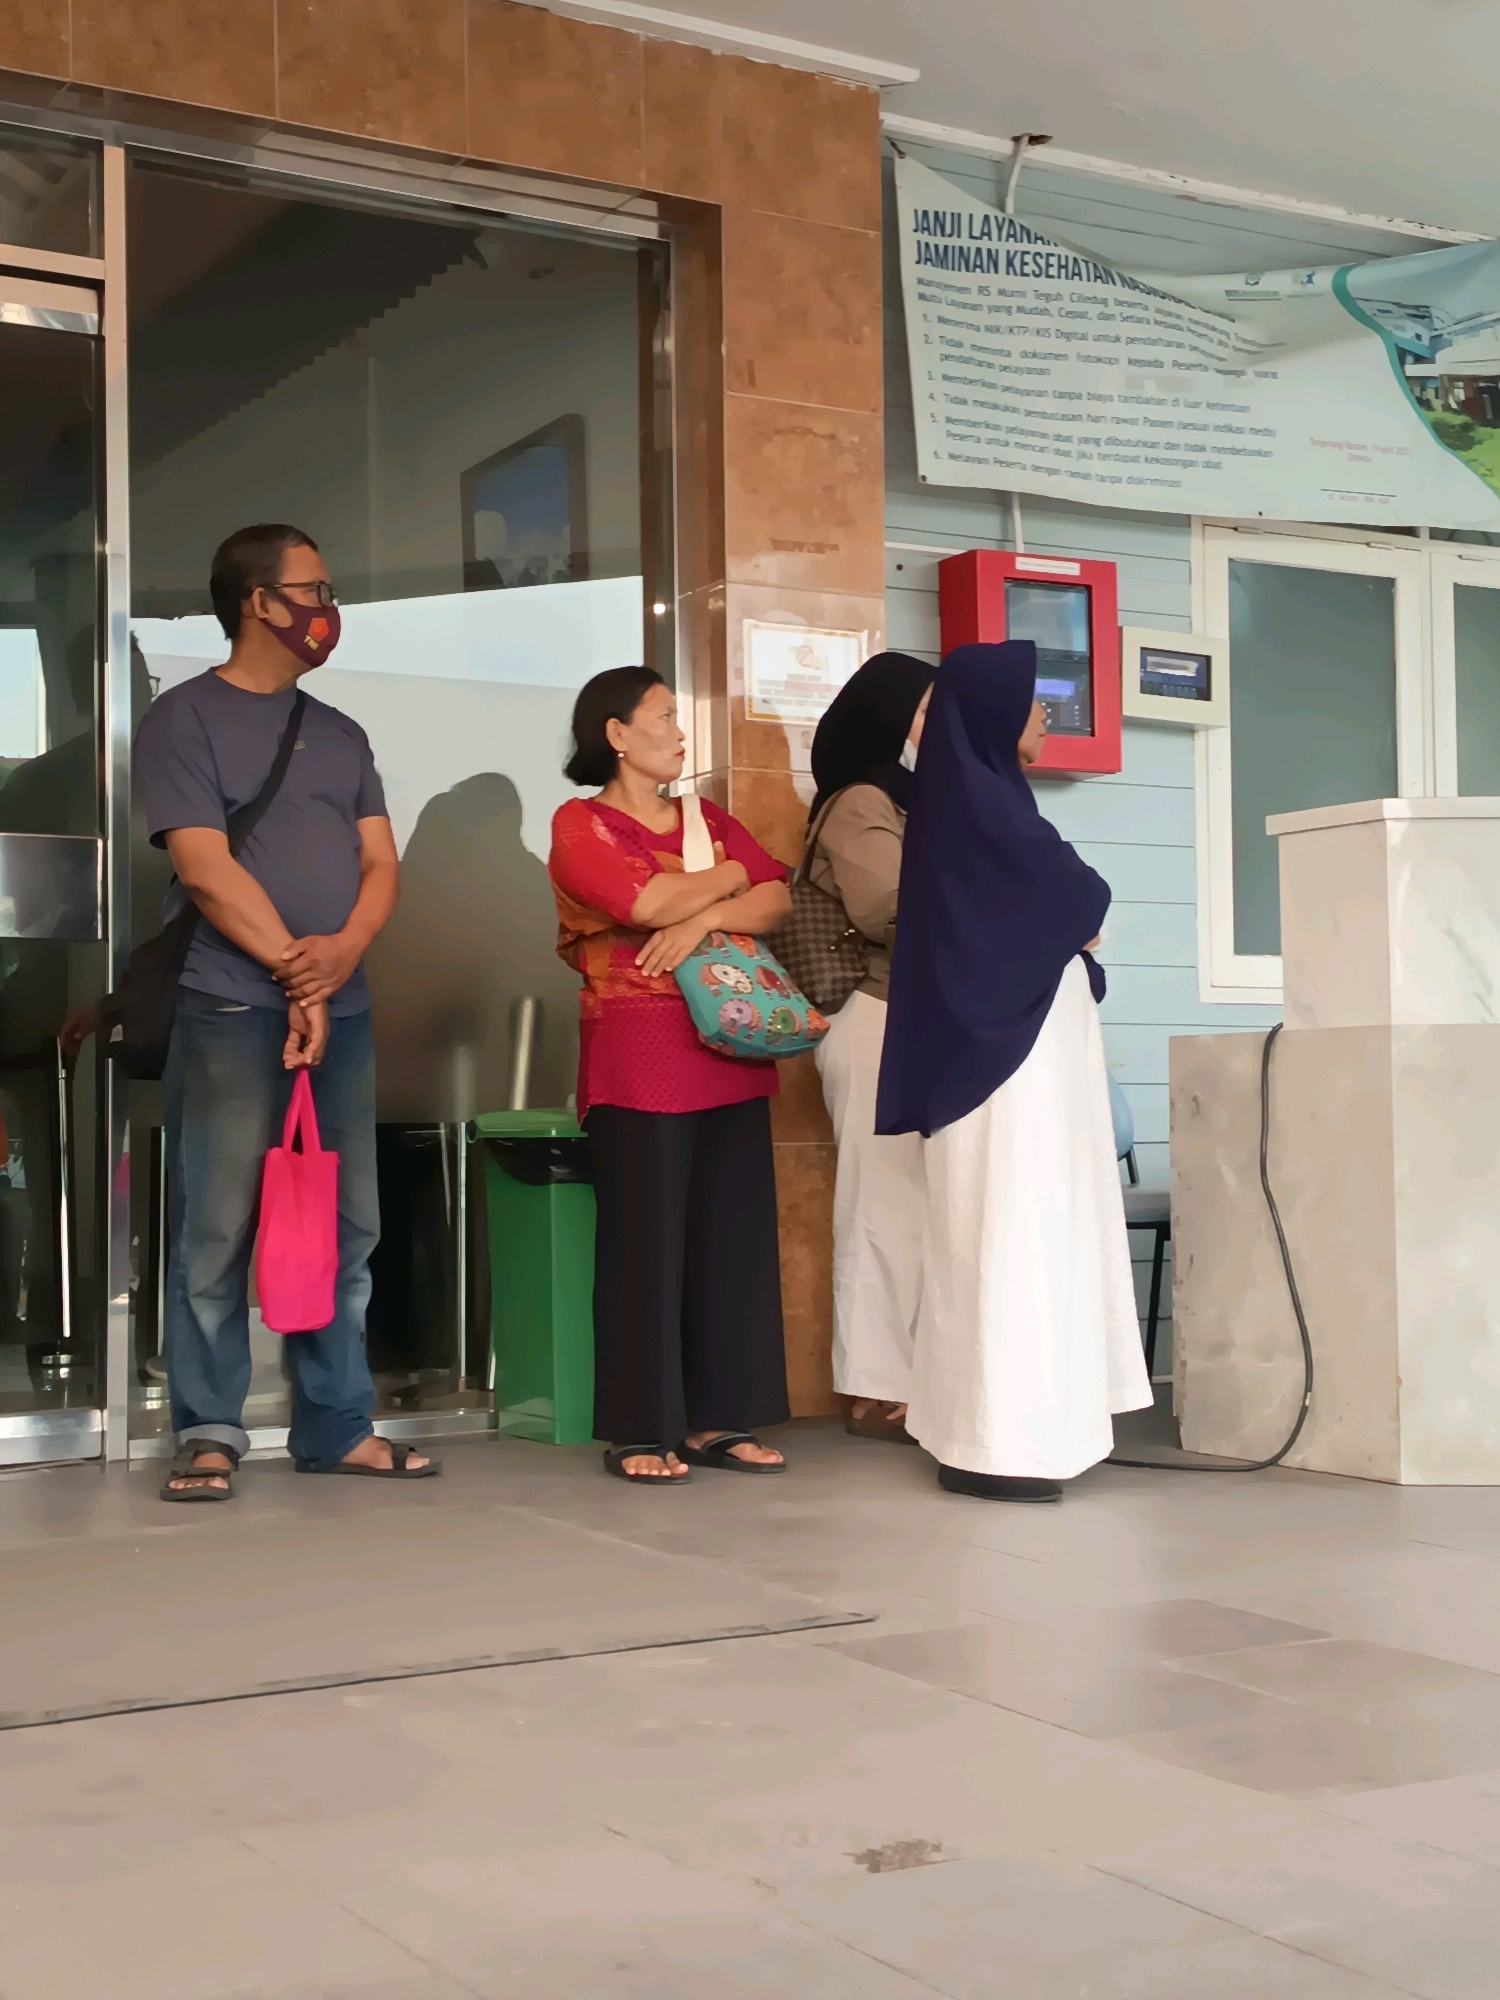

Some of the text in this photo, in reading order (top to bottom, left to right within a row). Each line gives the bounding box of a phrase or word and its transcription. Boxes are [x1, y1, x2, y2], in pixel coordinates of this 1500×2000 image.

[912, 208, 962, 238] JANJI
[915, 239, 999, 275] JAMINAN
[1005, 249, 1117, 287] KESEHATAN
[977, 285, 991, 297] RS
[1033, 289, 1064, 303] Teguh
[987, 303, 1013, 316] yang
[1055, 328, 1088, 342] Digital
[1019, 350, 1069, 362] dokumen
[999, 364, 1051, 376] pelayanan
[1077, 436, 1102, 448] yang
